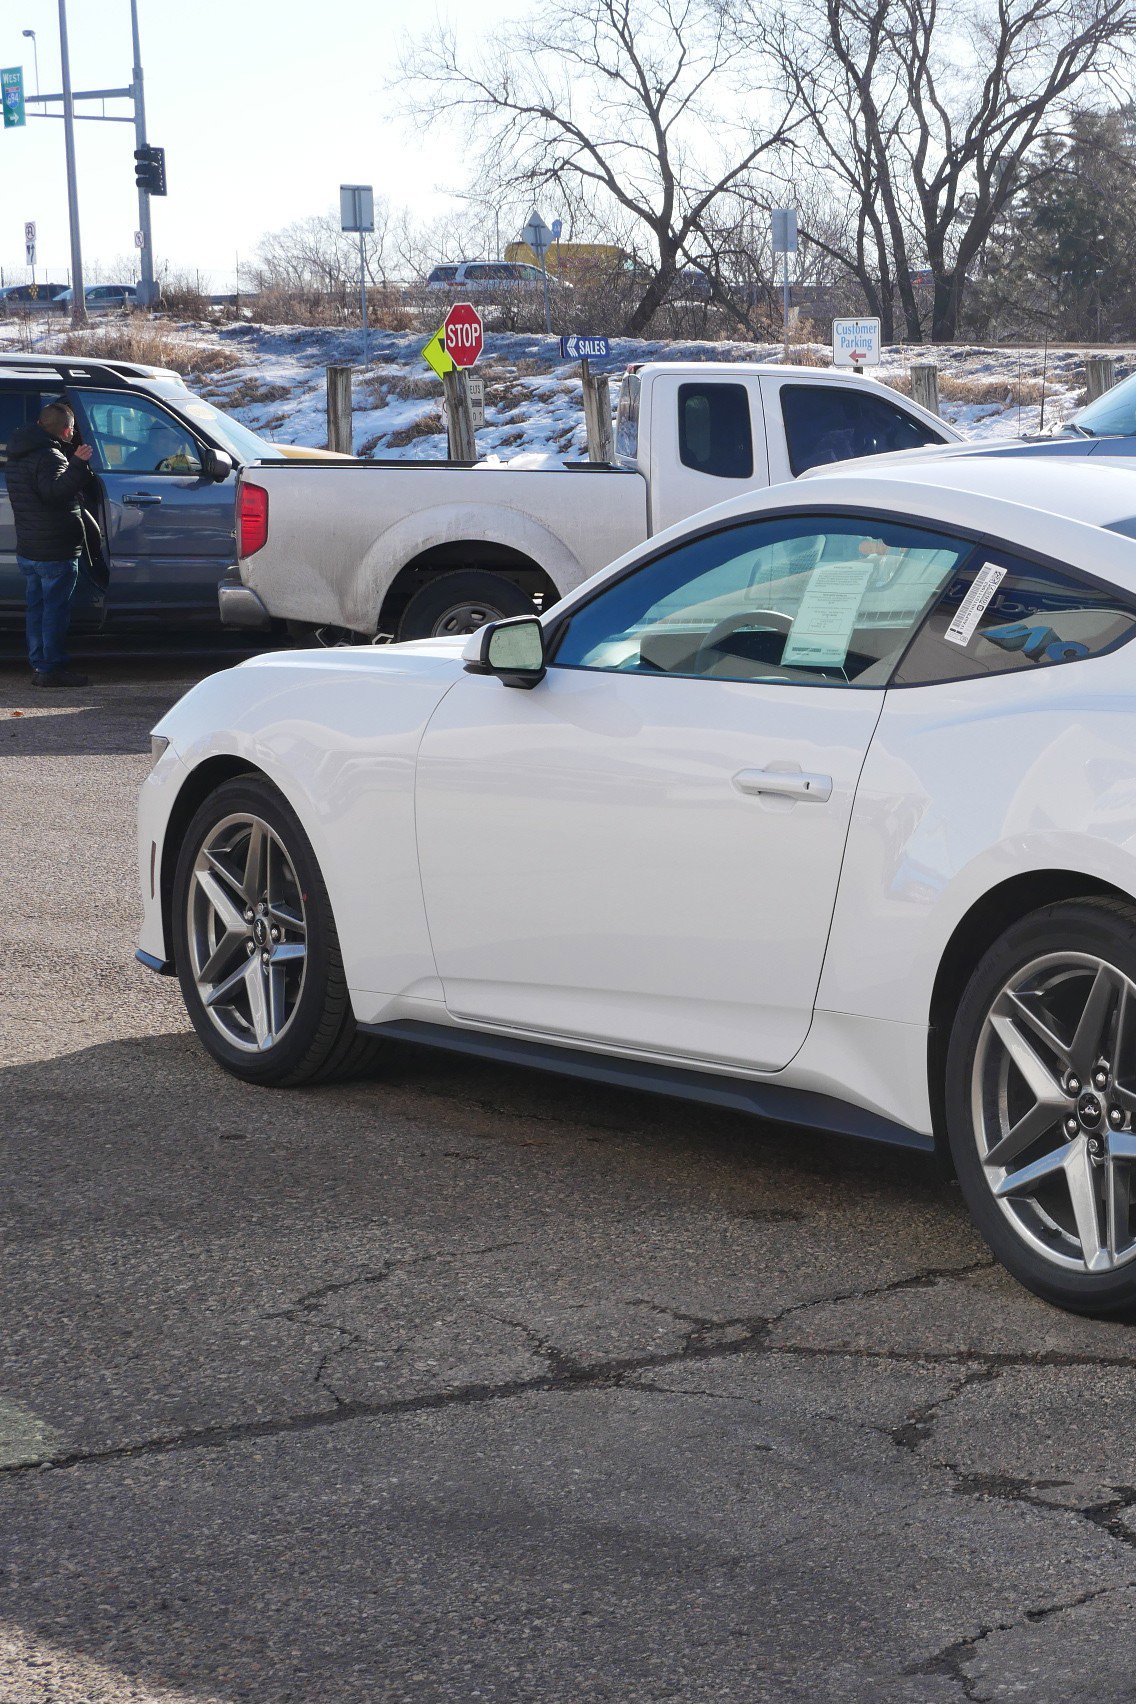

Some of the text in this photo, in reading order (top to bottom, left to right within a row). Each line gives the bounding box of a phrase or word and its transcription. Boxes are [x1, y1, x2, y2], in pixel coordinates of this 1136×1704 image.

[2, 73, 21, 84] WEST
[7, 92, 19, 104] 694
[447, 323, 480, 348] STOP
[836, 322, 877, 335] Customer
[578, 339, 606, 355] SALES
[841, 335, 873, 351] Parking
